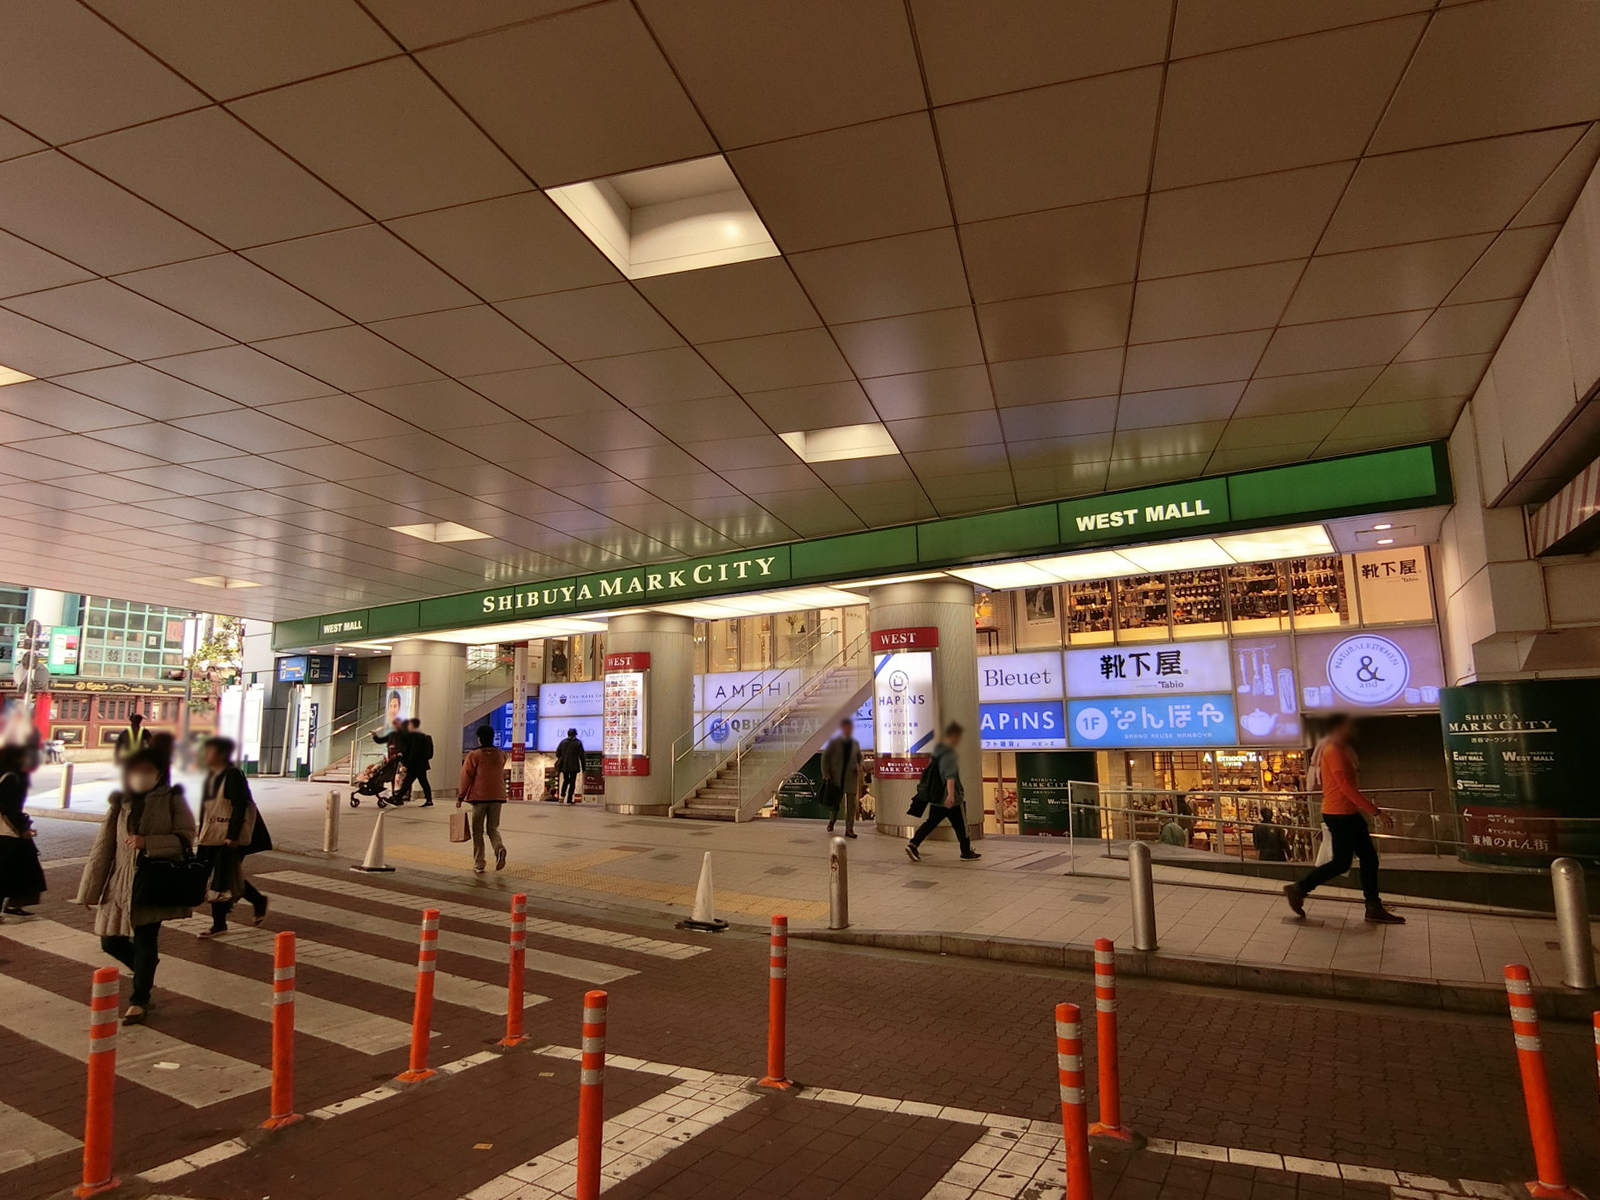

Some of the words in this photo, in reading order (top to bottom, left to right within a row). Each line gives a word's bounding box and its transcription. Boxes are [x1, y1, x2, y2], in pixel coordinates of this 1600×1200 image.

[1076, 509, 1138, 532] WEST
[1145, 500, 1210, 522] MALL
[1361, 559, 1417, 579] 靴下屋
[482, 583, 592, 613] SHIBUYA
[599, 569, 686, 598] MARK
[693, 556, 776, 584] CITY
[324, 622, 343, 634] WEST
[343, 621, 362, 632] MALL
[881, 633, 916, 645] WEST
[608, 657, 632, 666] WEST
[1100, 650, 1182, 680] 靴下屋
[984, 668, 1052, 687] Bleuet
[1158, 680, 1184, 689] Tabio
[1359, 680, 1378, 688] and
[715, 681, 791, 699] AMPHI
[981, 711, 1055, 731] APiNS
[1082, 717, 1099, 731] 1F
[1111, 703, 1224, 731] なんぼや
[1449, 722, 1493, 731] MARK
[1499, 720, 1553, 730] CITY
[1502, 752, 1531, 762] WEST
[1472, 834, 1548, 851] 東横のれん街
